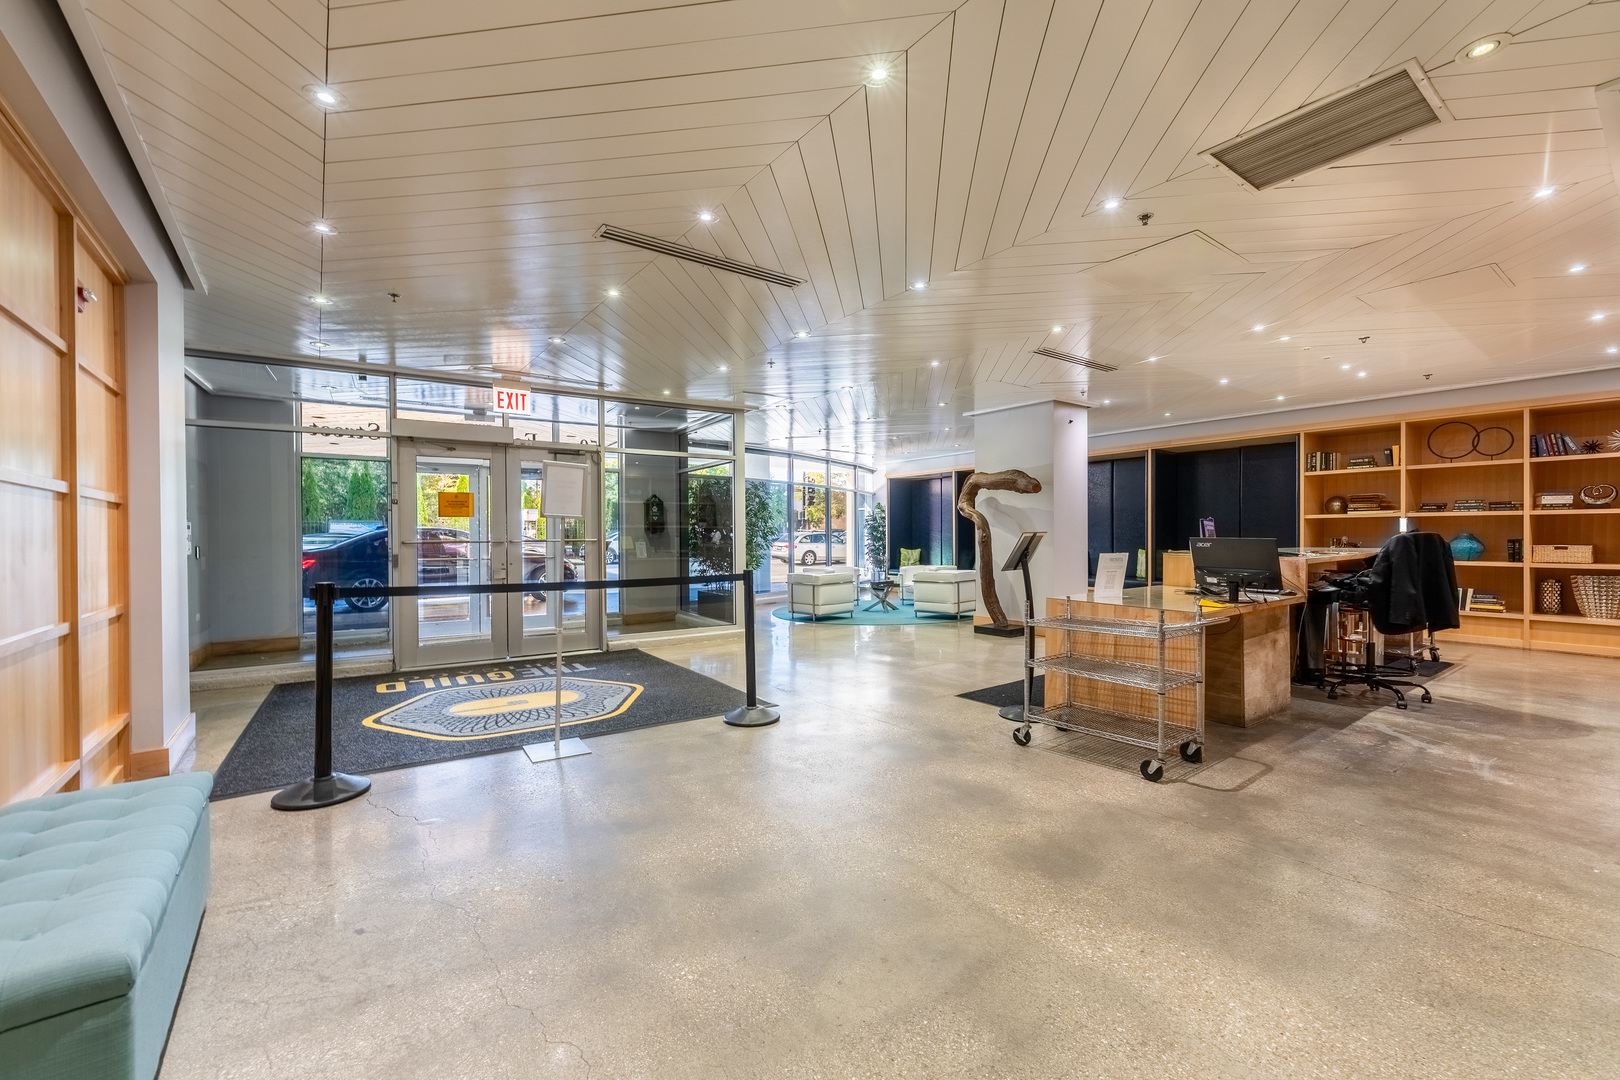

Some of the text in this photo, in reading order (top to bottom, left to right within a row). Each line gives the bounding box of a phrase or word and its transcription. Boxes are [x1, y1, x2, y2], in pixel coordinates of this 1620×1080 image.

[497, 390, 527, 411] EXIT
[516, 662, 597, 678] THE
[376, 670, 515, 694] GUILD
